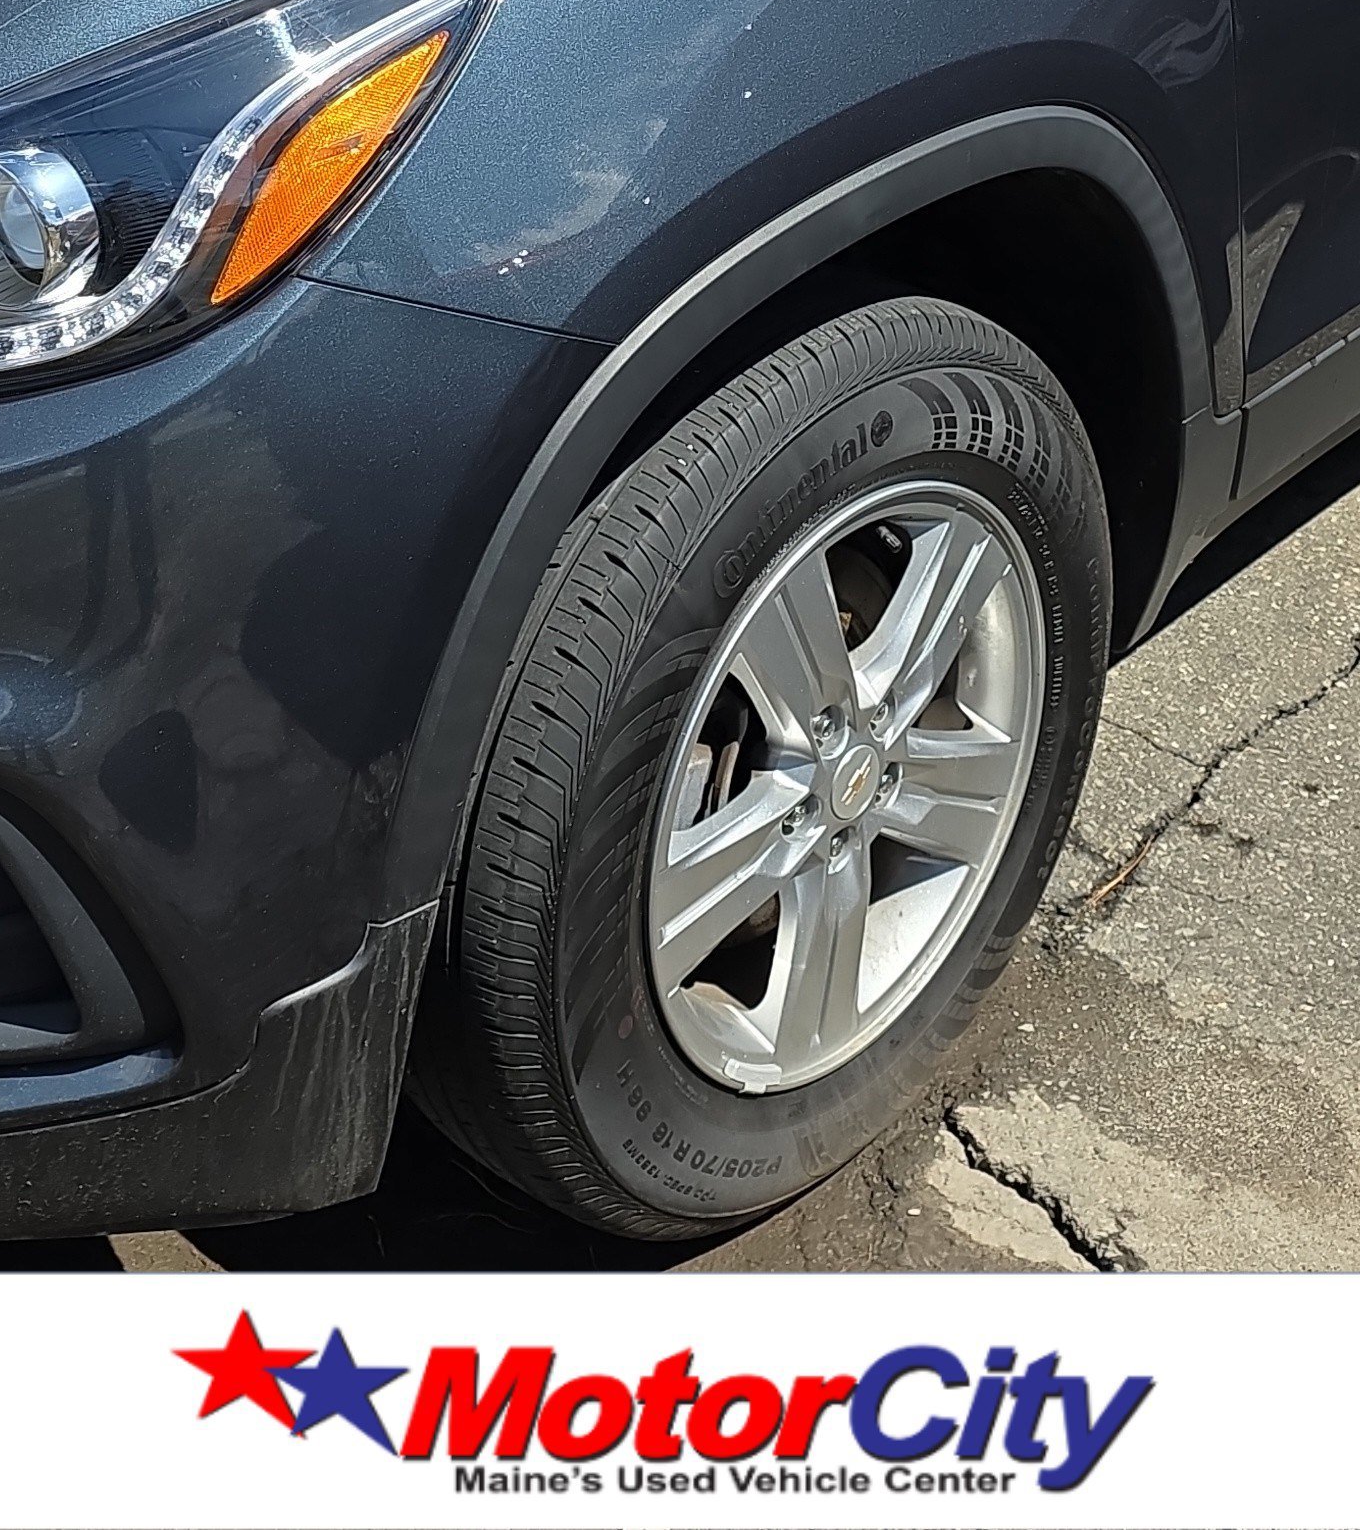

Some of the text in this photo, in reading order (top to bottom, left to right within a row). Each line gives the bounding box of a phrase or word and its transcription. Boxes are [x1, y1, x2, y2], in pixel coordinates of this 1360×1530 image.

[713, 421, 869, 598] Continental
[616, 1059, 634, 1088] H
[651, 1121, 674, 1149] 16
[672, 1138, 692, 1163] R
[690, 1148, 783, 1179] P205/70
